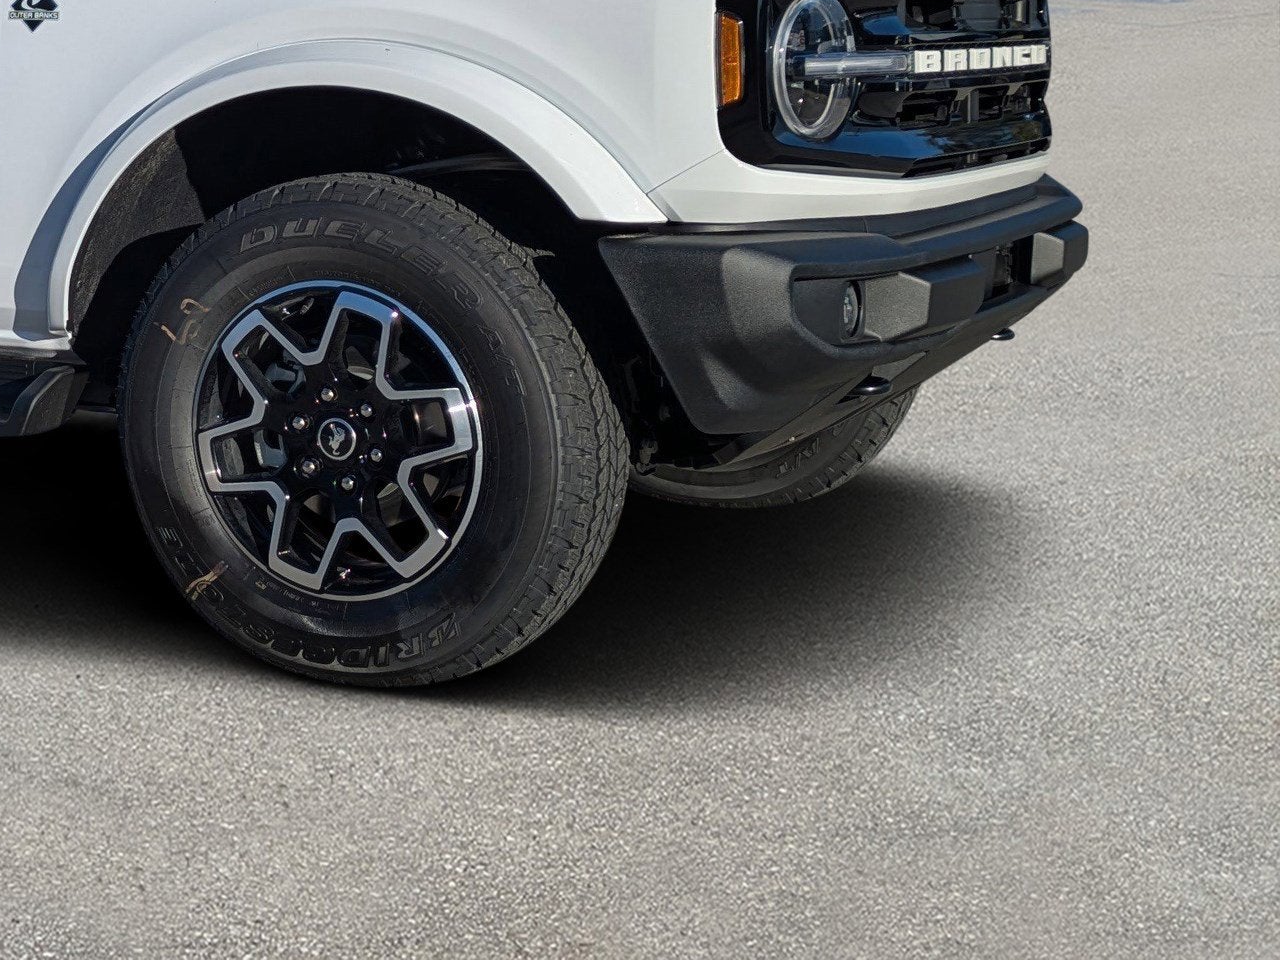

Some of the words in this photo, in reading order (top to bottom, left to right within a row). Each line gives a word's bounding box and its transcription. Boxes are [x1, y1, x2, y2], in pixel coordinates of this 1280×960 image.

[9, 11, 33, 20] OUTER
[34, 11, 58, 20] BANKS
[914, 44, 1048, 73] BRONCO
[239, 217, 484, 310] DUELER
